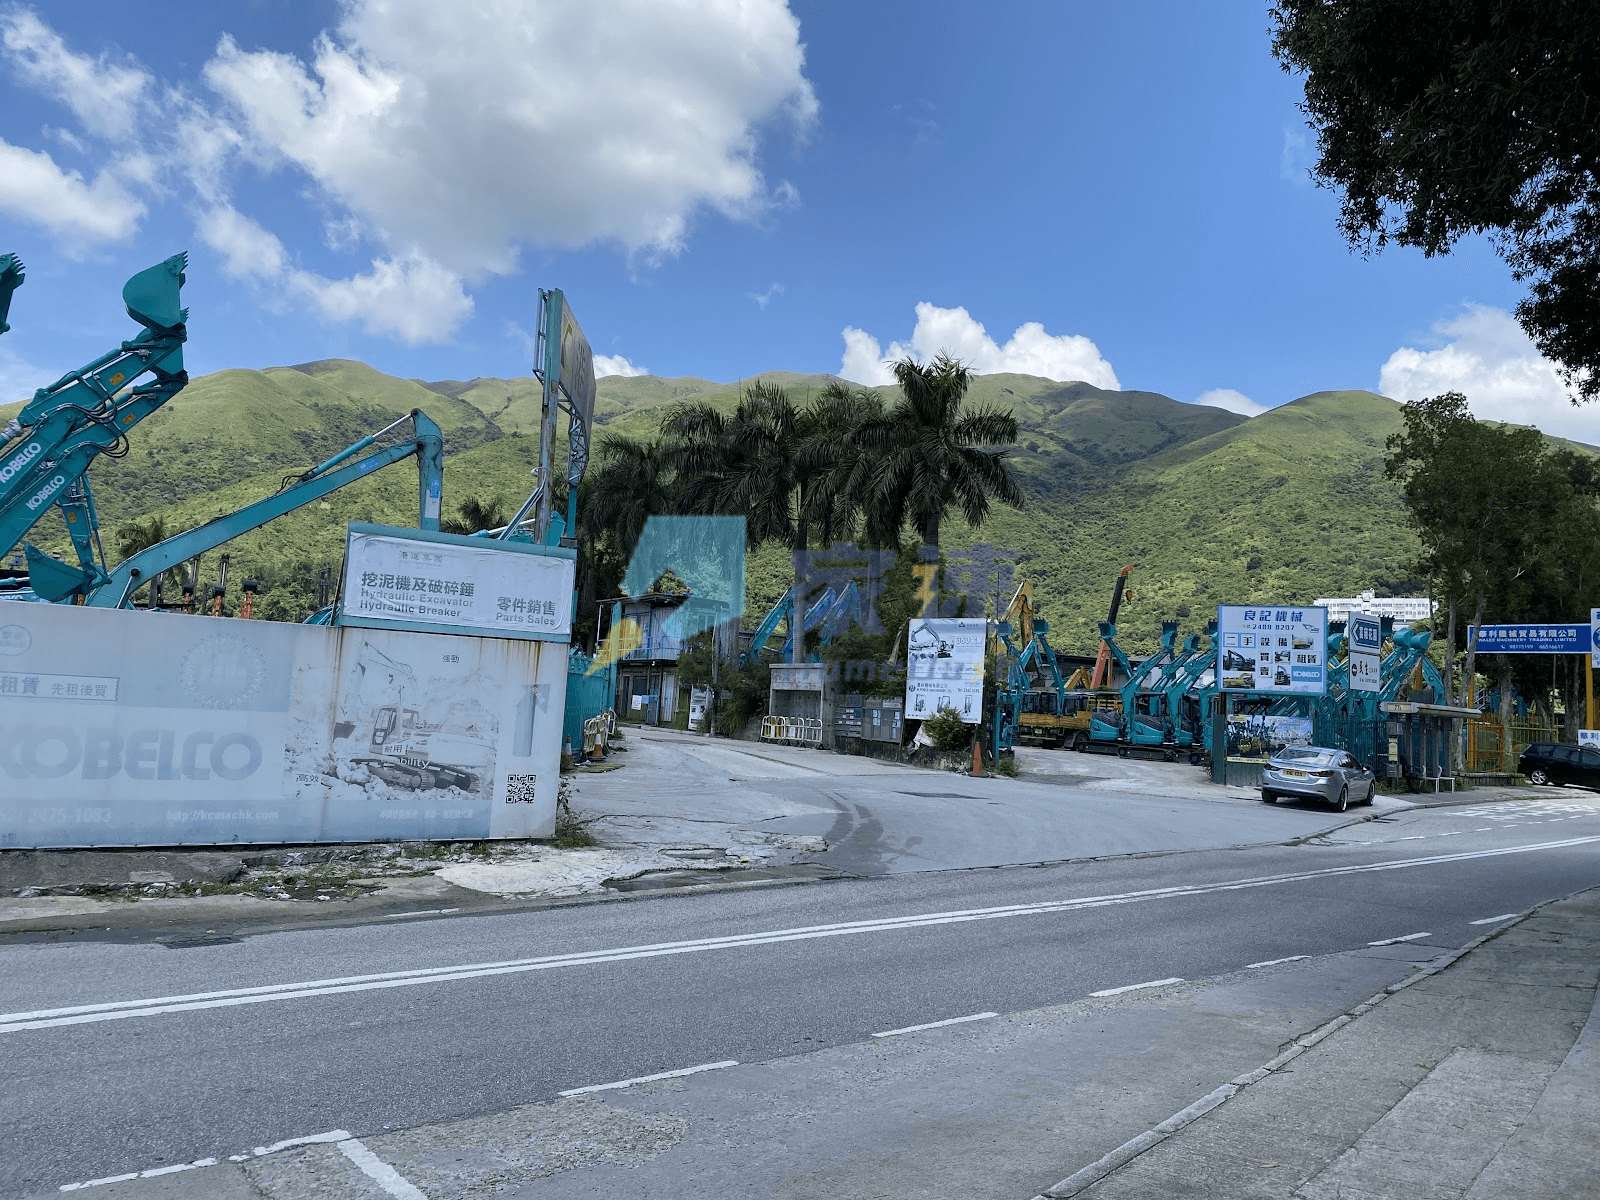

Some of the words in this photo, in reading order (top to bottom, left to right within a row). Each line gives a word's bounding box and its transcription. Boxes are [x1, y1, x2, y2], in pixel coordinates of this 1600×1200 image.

[26, 475, 65, 510] KOBELCO
[361, 587, 416, 602] Hydraulic
[419, 593, 474, 608] Excavator
[497, 596, 556, 616] 零件銷售
[359, 600, 415, 614] Hydraulic
[418, 606, 462, 618] Breaker
[1244, 610, 1304, 623] 良記機械
[496, 612, 524, 623] Parts
[527, 615, 556, 626] Sales
[51, 683, 107, 698] 先租後買
